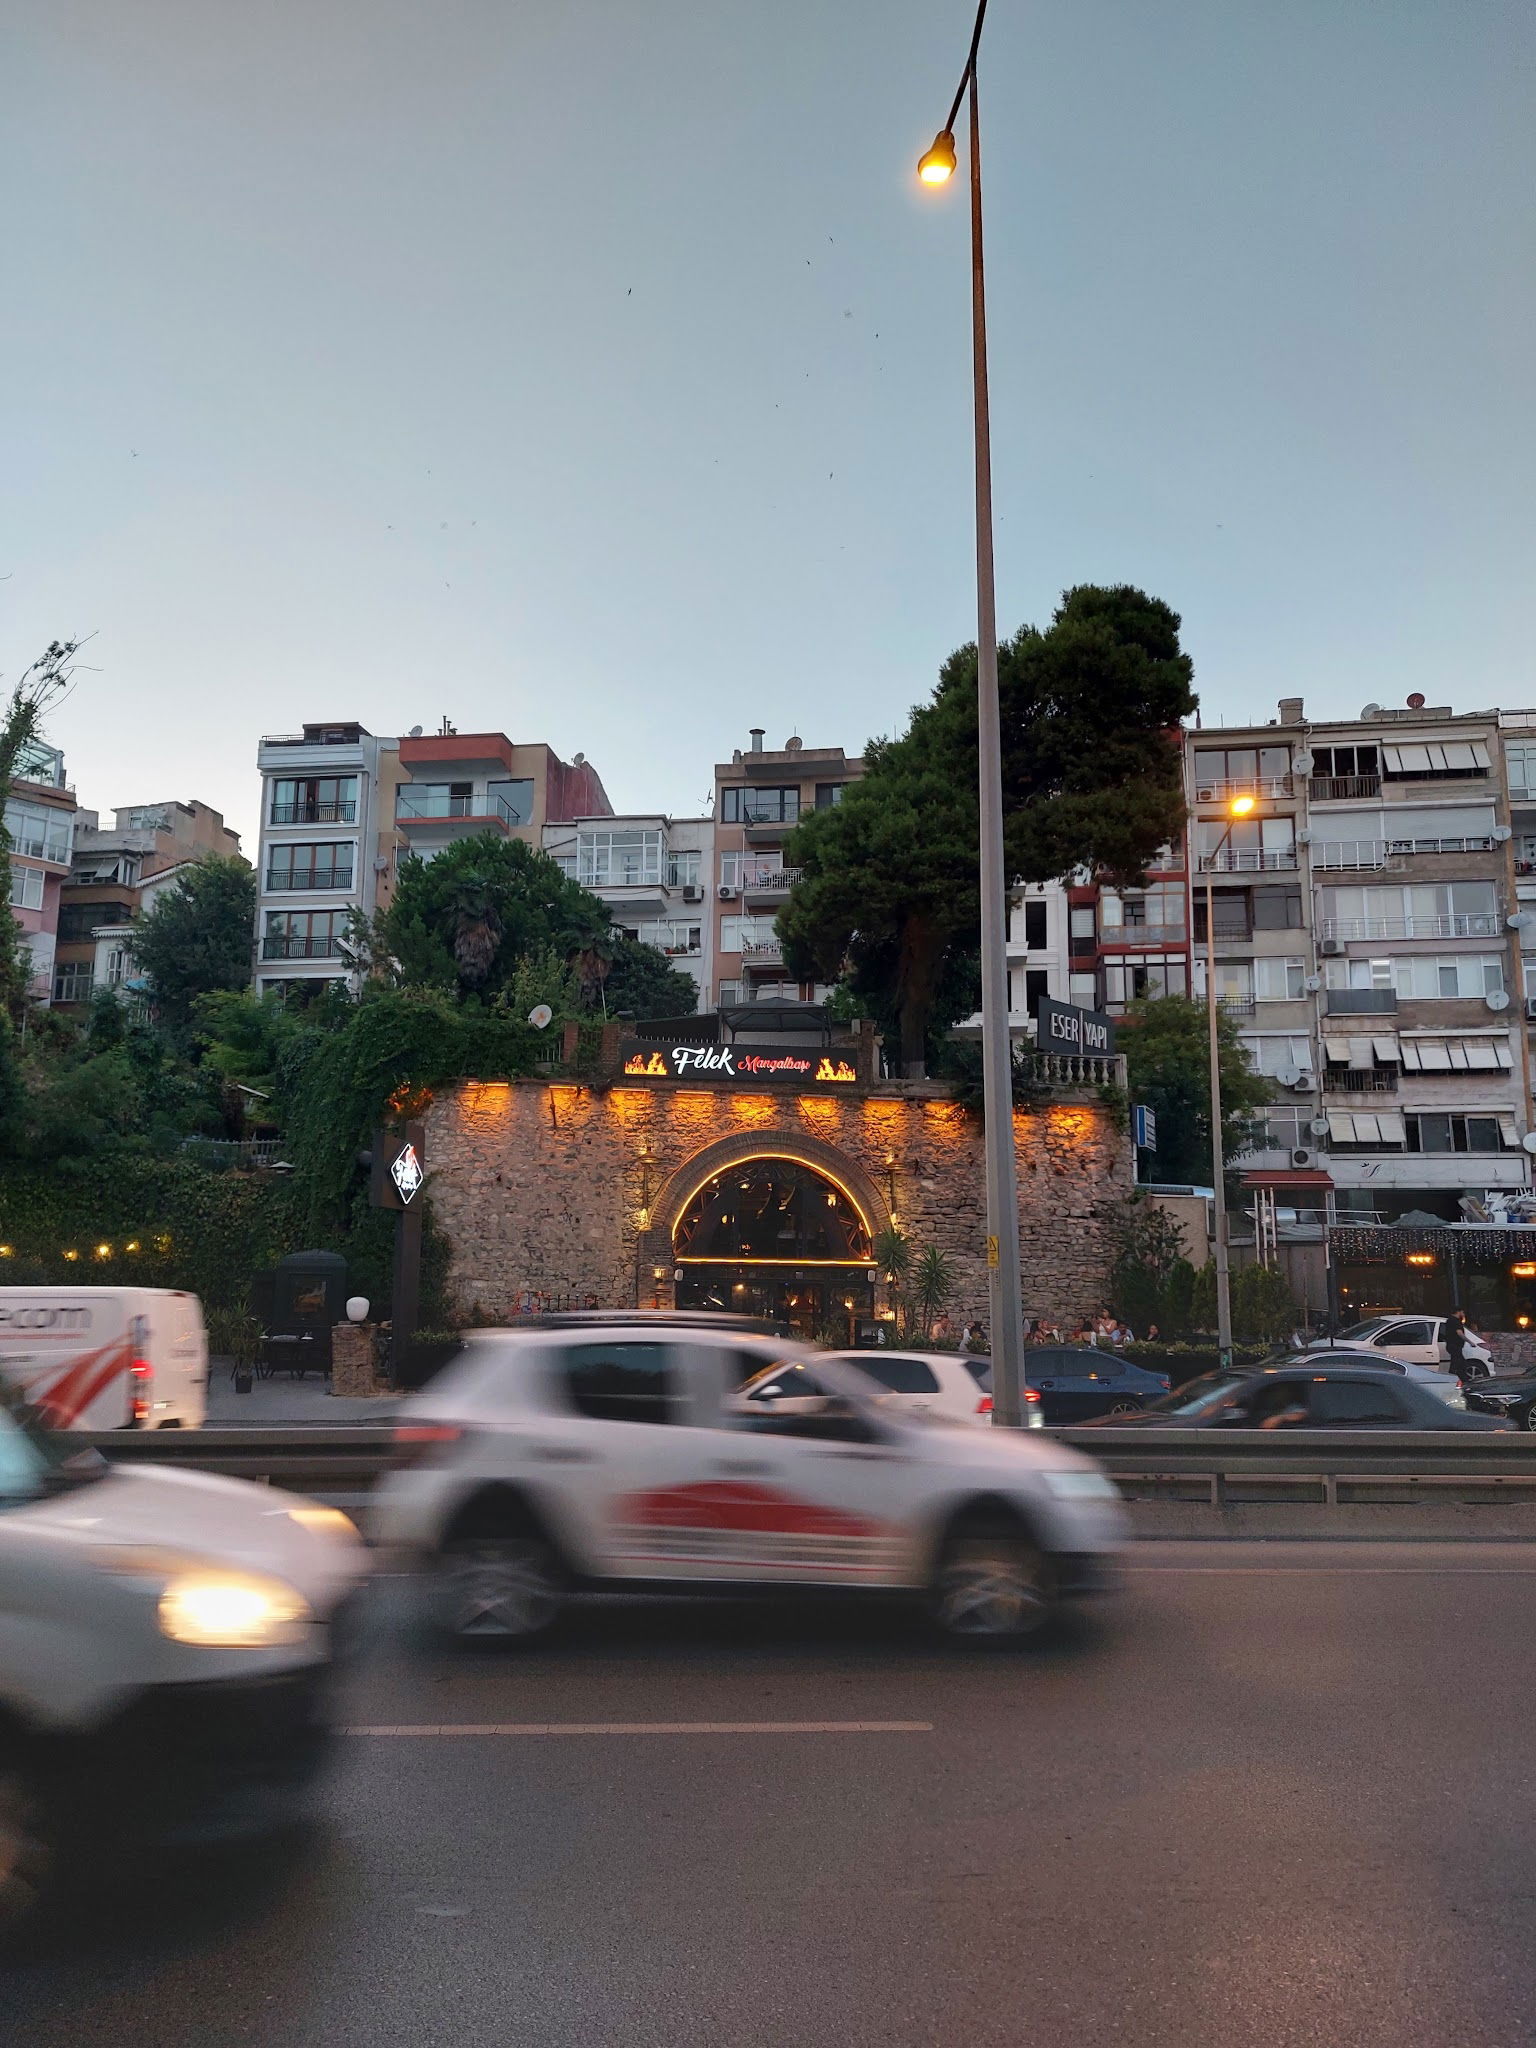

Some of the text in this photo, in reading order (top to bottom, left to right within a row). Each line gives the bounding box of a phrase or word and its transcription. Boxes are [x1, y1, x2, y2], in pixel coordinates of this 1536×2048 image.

[1051, 1012, 1107, 1050] ESER YAPI
[672, 1047, 735, 1075] Felek
